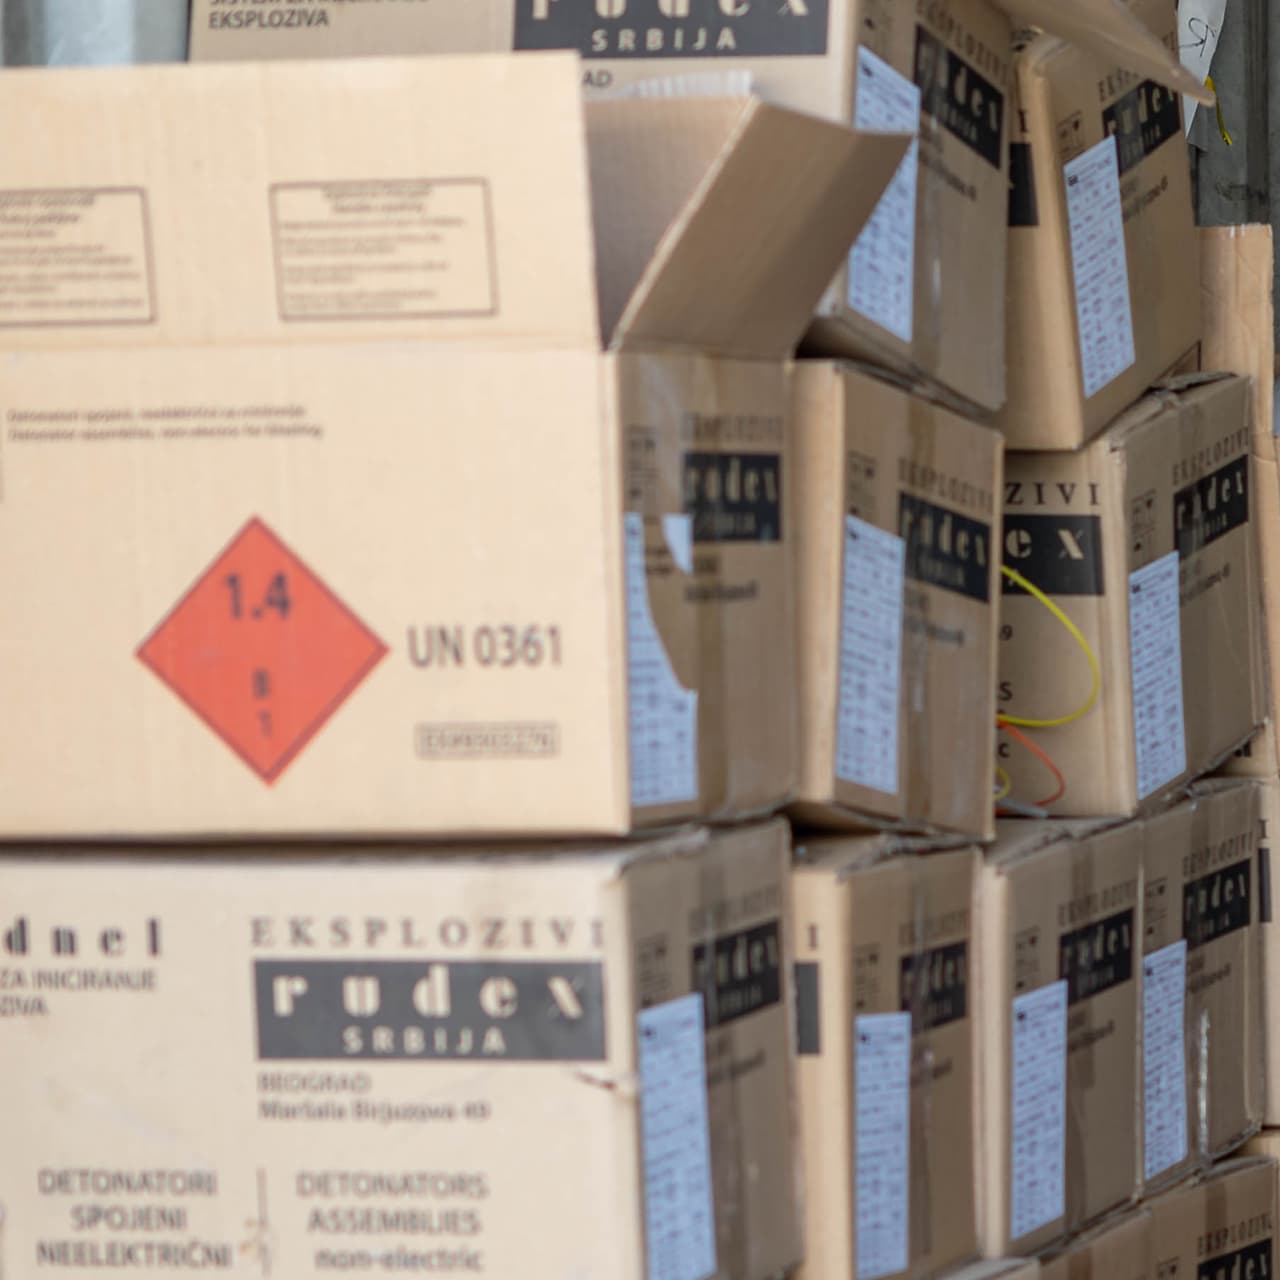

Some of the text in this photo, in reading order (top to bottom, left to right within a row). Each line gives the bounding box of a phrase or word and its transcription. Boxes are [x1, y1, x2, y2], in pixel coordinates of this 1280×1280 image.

[208, 9, 330, 31] EKSPLOZIVA
[590, 27, 739, 53] SRBIJA
[222, 571, 293, 622] 1.4
[406, 623, 564, 670] UN 0361
[4, 916, 163, 958] dnel
[250, 915, 606, 952] EKSPLOZIVI
[271, 963, 586, 1019] rudex
[343, 1025, 508, 1056] SRBIJA
[256, 1071, 372, 1096] BEOGRAD
[37, 1167, 219, 1198] DETONATORI
[295, 1169, 490, 1201] DETONATORS
[70, 1203, 187, 1232] SPOJENI
[306, 1206, 481, 1236] ASSEMBLIES
[35, 1235, 234, 1270] NEELEKTRIČNI
[314, 1242, 485, 1274] non-electric
